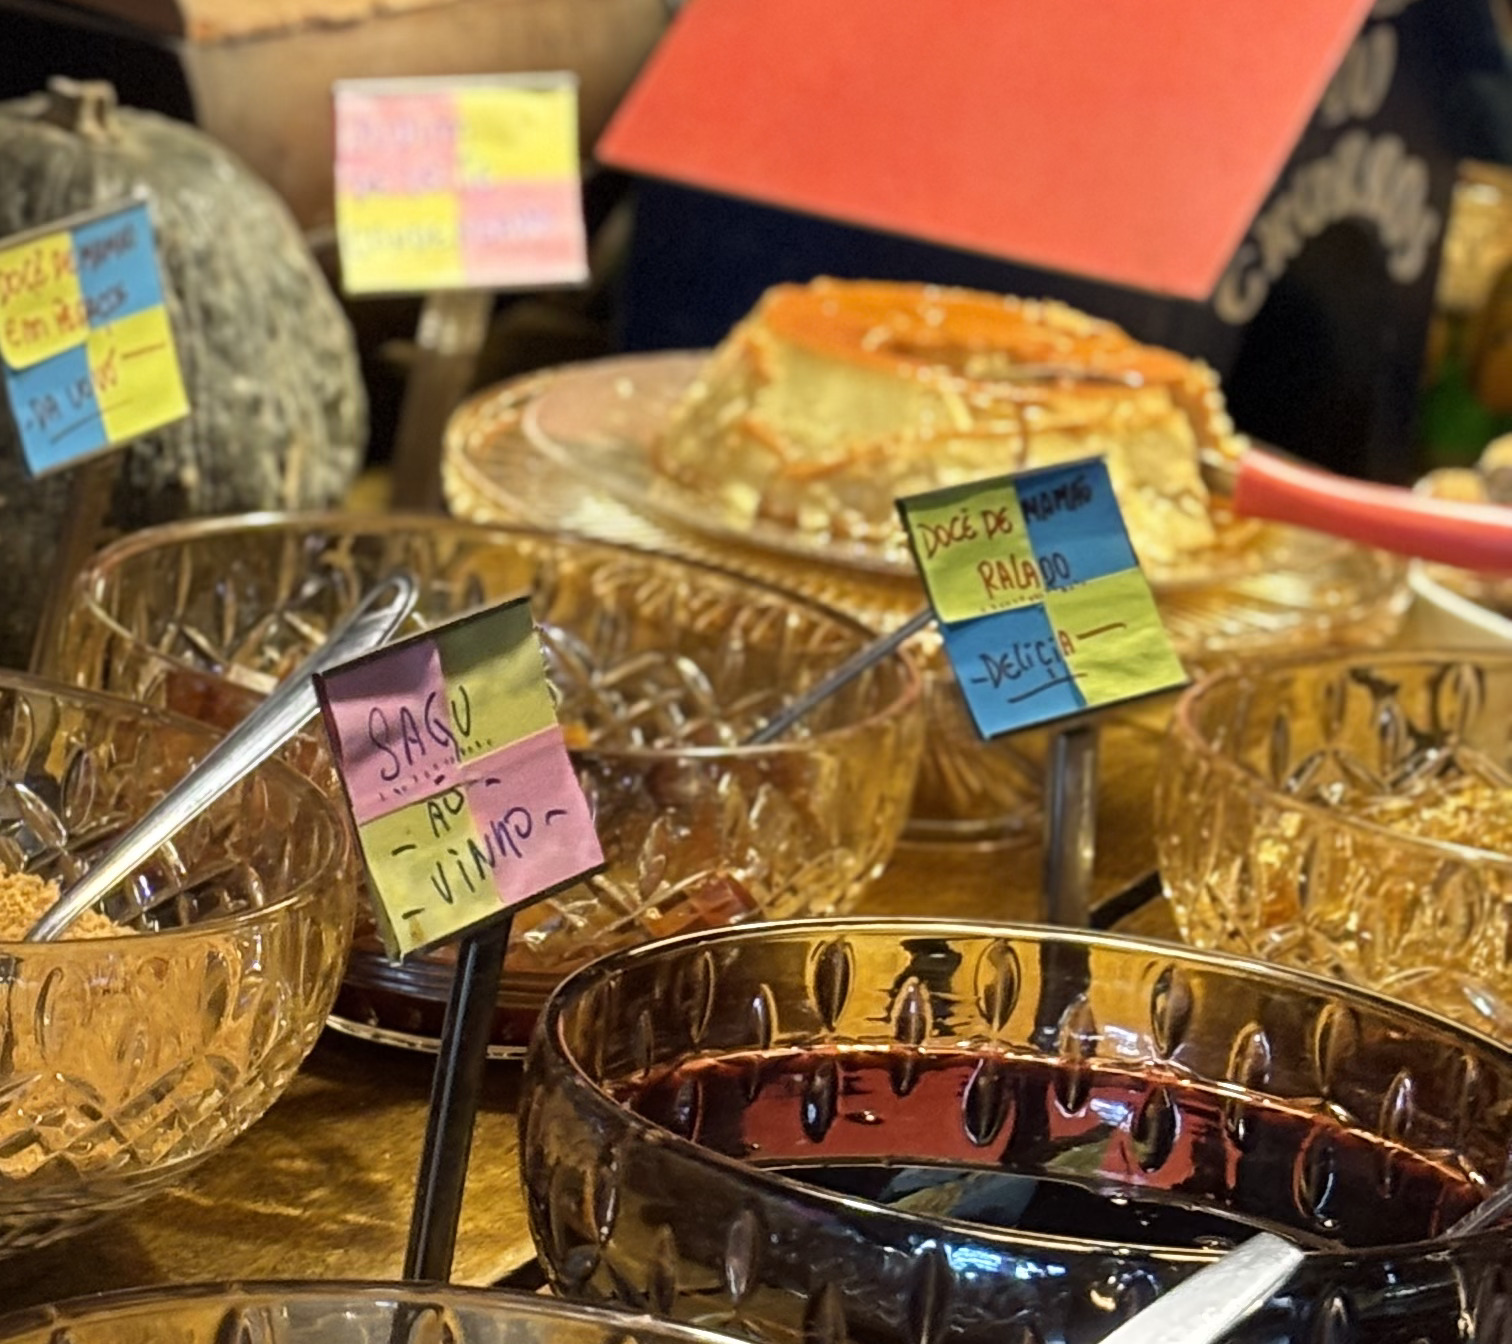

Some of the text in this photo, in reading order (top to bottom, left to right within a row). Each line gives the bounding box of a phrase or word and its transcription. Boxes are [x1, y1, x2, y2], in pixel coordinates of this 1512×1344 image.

[981, 507, 1014, 542] DE
[978, 552, 1071, 601] RALADO
[368, 684, 471, 782] SAGU
[427, 787, 465, 838] AO
